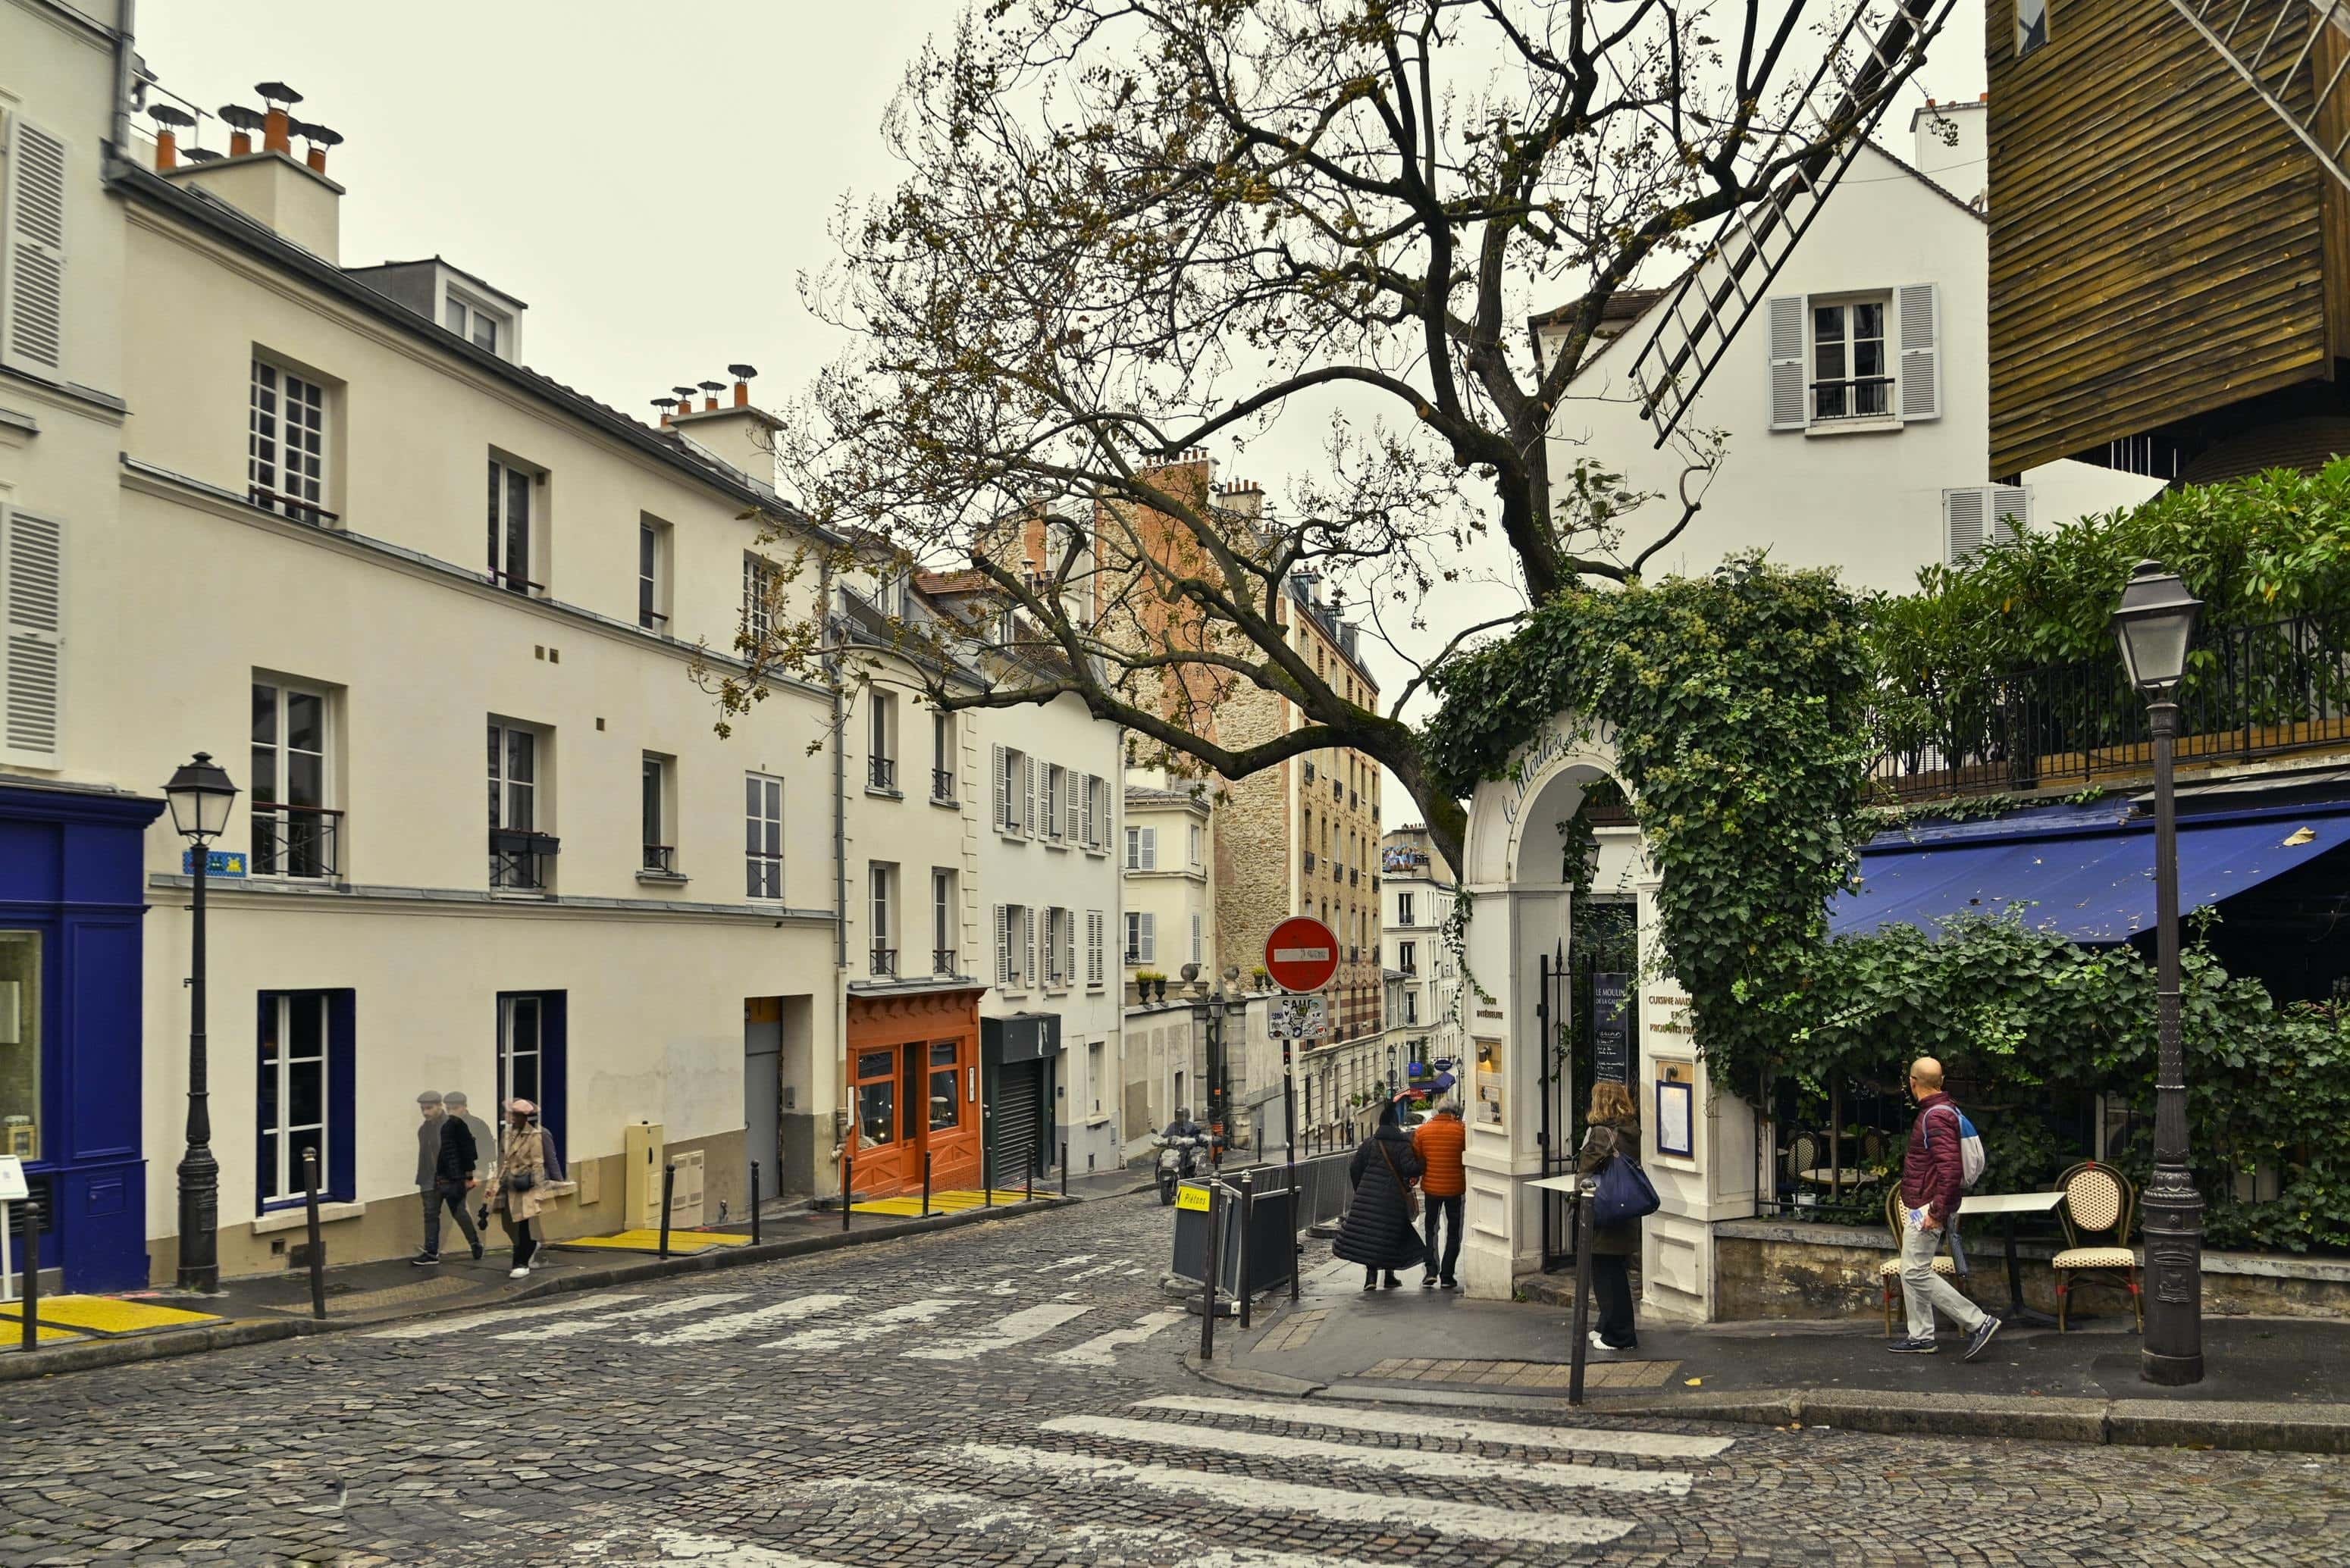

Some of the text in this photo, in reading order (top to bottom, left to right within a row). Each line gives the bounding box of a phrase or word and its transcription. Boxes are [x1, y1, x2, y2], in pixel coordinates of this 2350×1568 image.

[1595, 987, 1625, 997] LE MOULIN
[1649, 996, 1674, 1005] CUISINE
